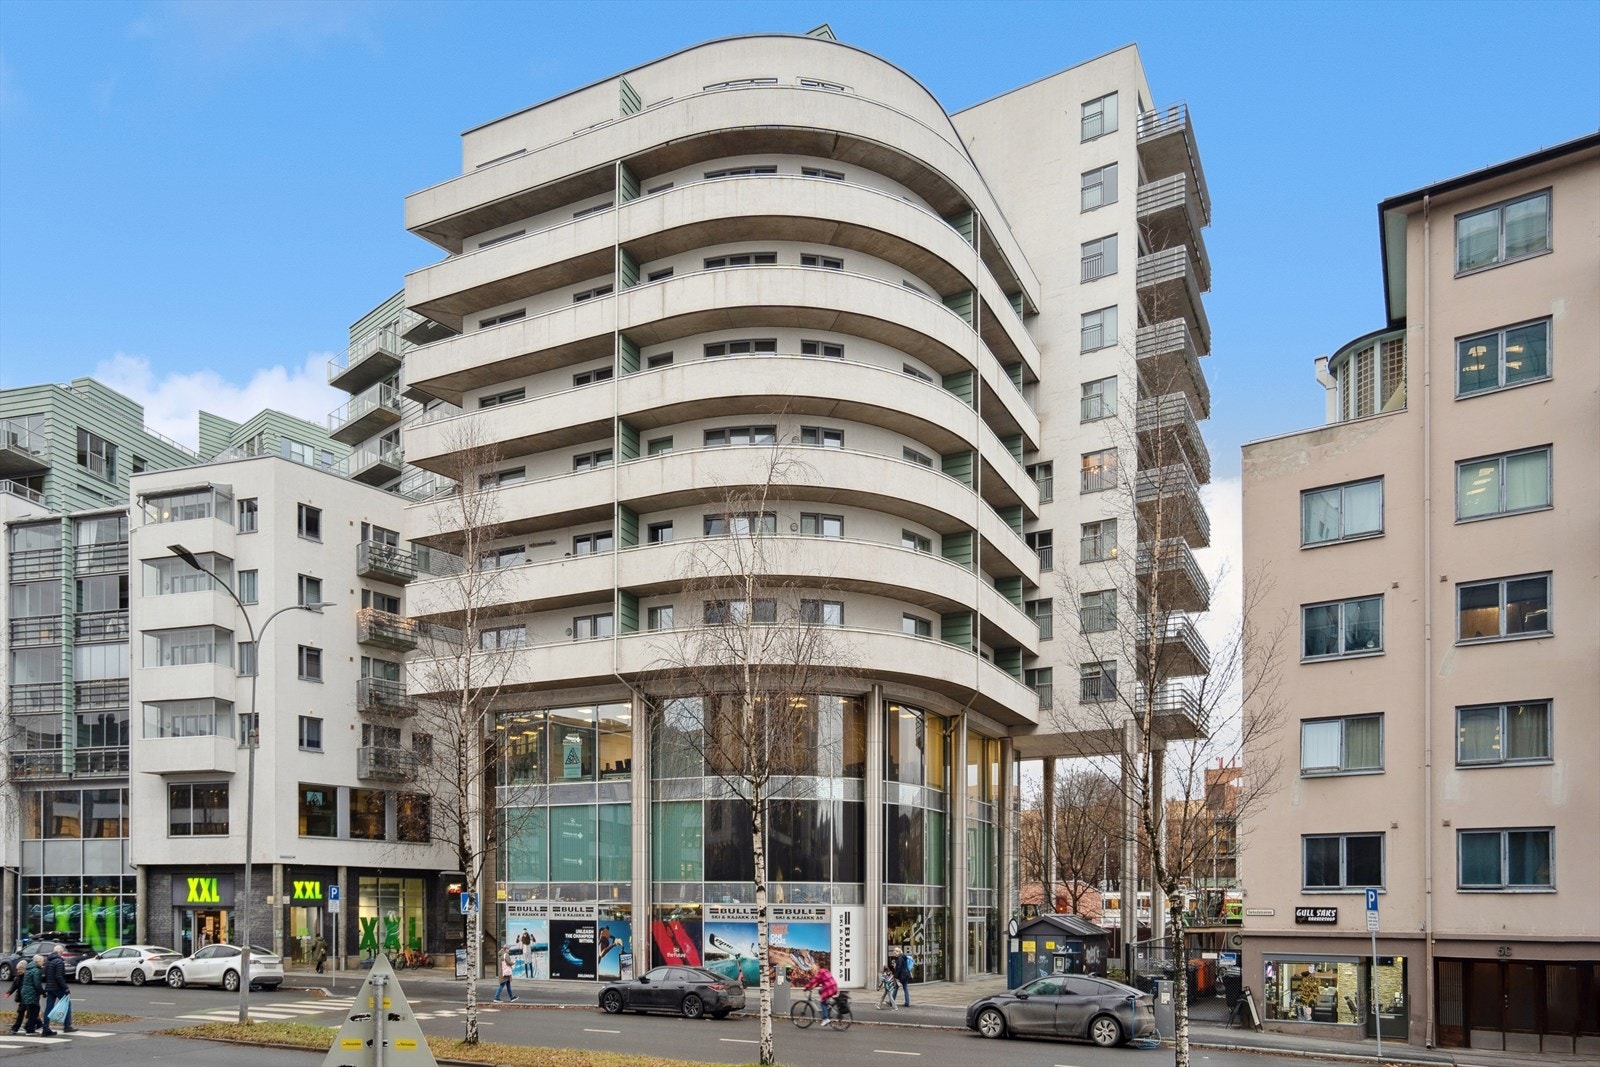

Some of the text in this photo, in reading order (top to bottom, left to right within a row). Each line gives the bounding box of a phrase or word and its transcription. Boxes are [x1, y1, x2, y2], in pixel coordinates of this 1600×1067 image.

[187, 878, 220, 903] XXL
[293, 881, 322, 899] XXL
[331, 887, 338, 899] P
[1368, 890, 1376, 909] P
[1296, 908, 1337, 917] GULL SAKS
[360, 916, 421, 950] XXL
[903, 944, 932, 956] BULL
